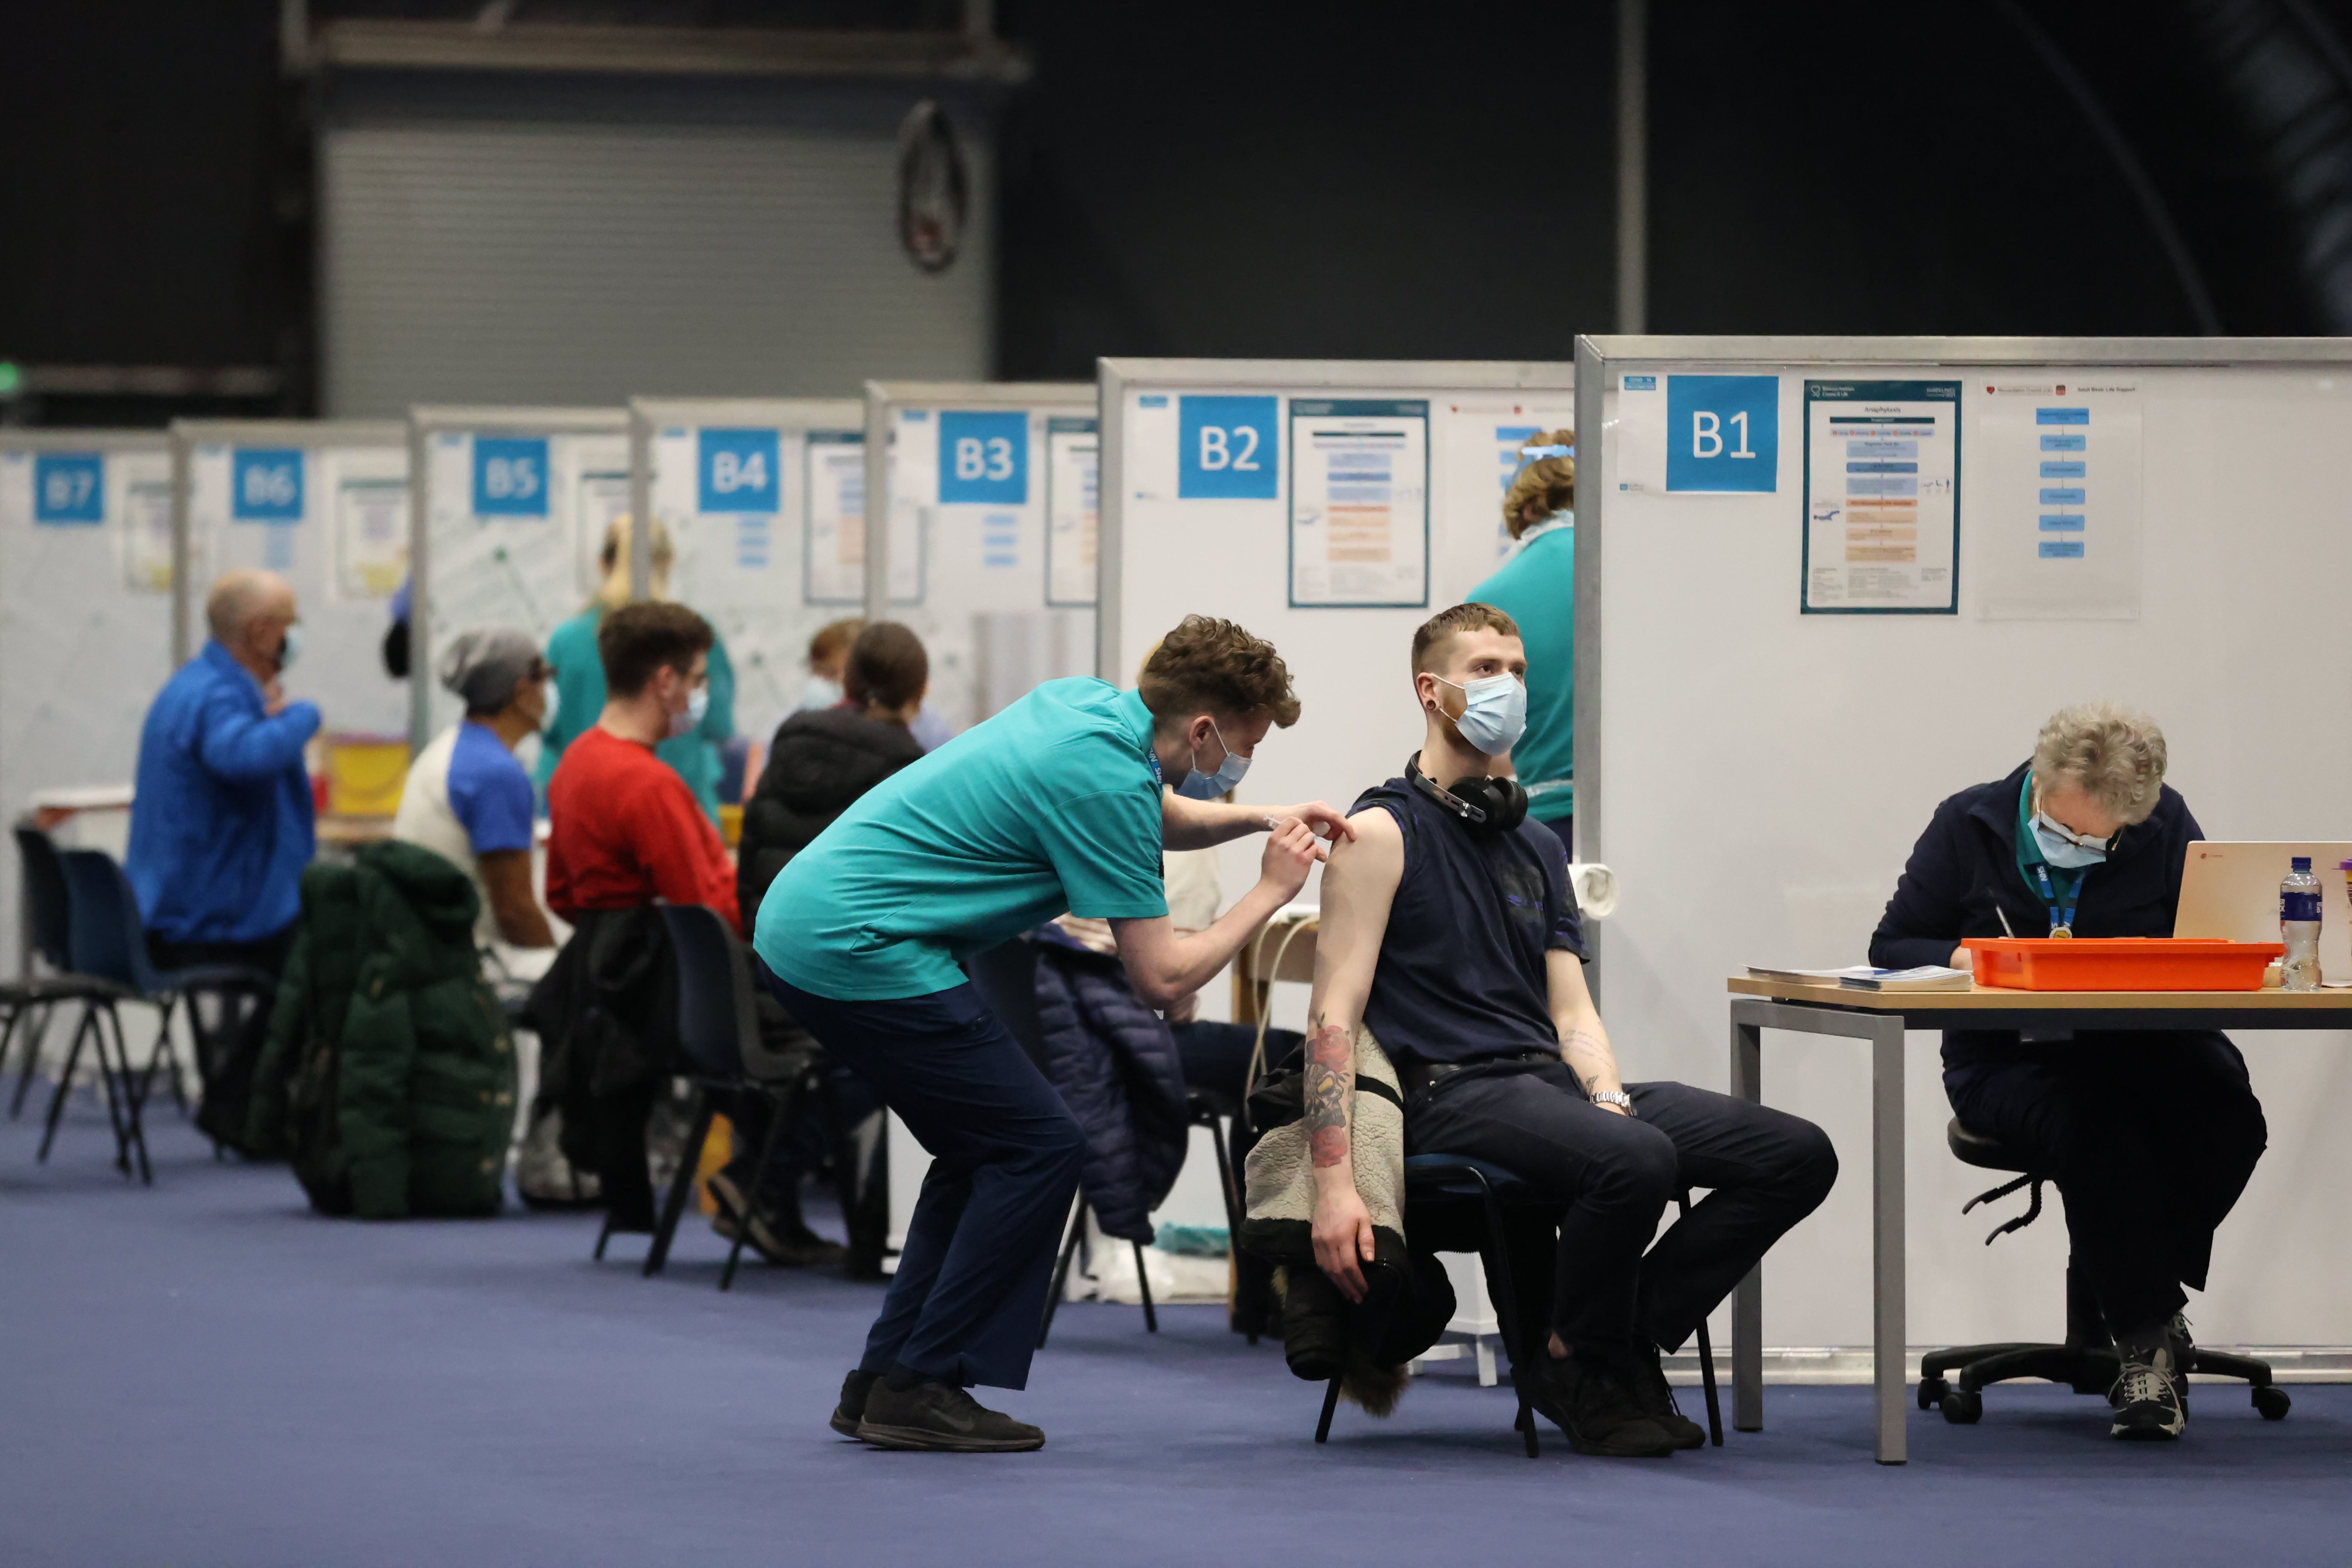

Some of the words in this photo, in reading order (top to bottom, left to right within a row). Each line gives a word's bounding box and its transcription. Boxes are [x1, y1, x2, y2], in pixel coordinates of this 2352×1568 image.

[1200, 425, 1260, 471] B2
[1694, 411, 1756, 459] B1
[486, 457, 539, 499] B5
[713, 451, 769, 493] B4
[956, 438, 1015, 481] B3
[45, 472, 95, 510] B7
[244, 464, 297, 506] B6
[2037, 866, 2048, 881] NHS
